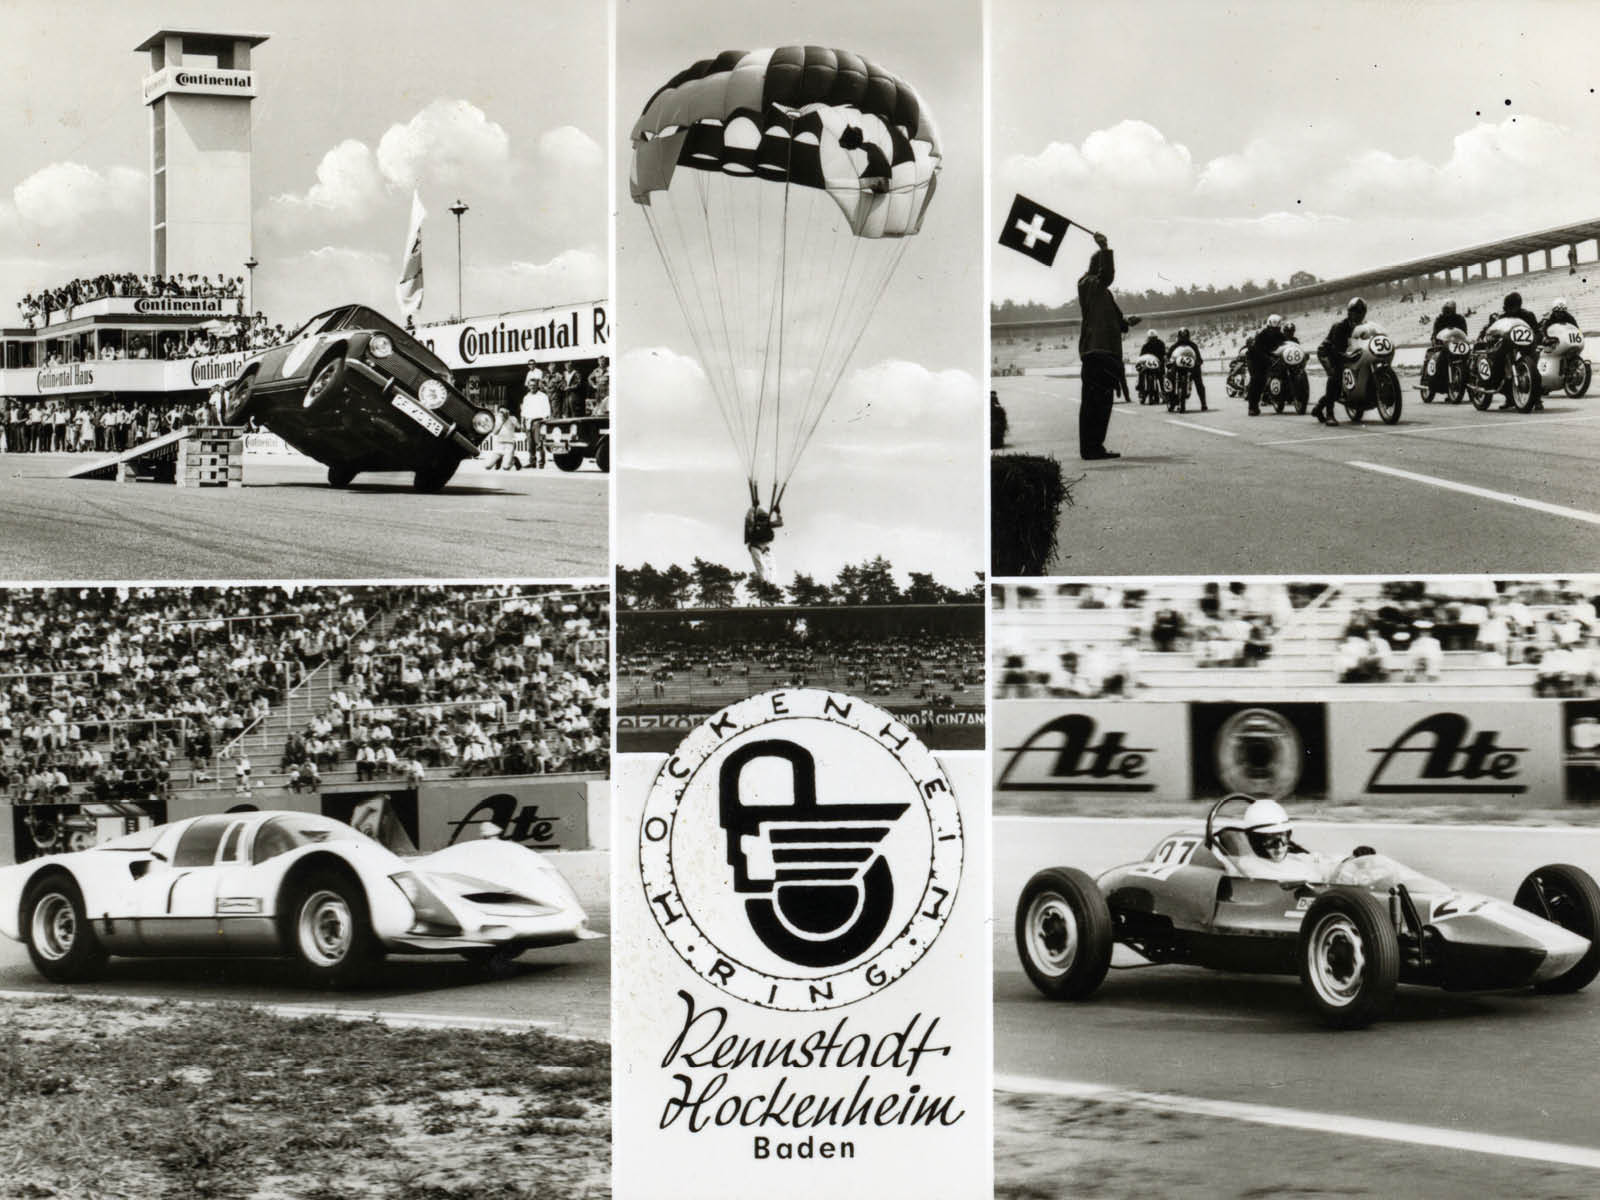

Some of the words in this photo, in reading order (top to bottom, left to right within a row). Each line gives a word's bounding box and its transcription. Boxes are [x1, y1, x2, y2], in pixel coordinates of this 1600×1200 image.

[175, 72, 251, 87] Continental
[134, 298, 222, 313] Continental
[459, 311, 579, 364] Continental
[1374, 338, 1391, 352] 50
[1513, 329, 1531, 343] 122
[1568, 332, 1582, 343] 116
[1286, 350, 1300, 361] 68
[1452, 342, 1466, 353] 70
[75, 363, 94, 385] Haus
[996, 713, 1157, 791] Ate
[1364, 712, 1530, 793] Ate
[448, 793, 560, 848] Ate
[661, 989, 951, 1077] Rennstadt
[659, 1072, 966, 1133] Hockenheim
[753, 1135, 856, 1160] Baden
